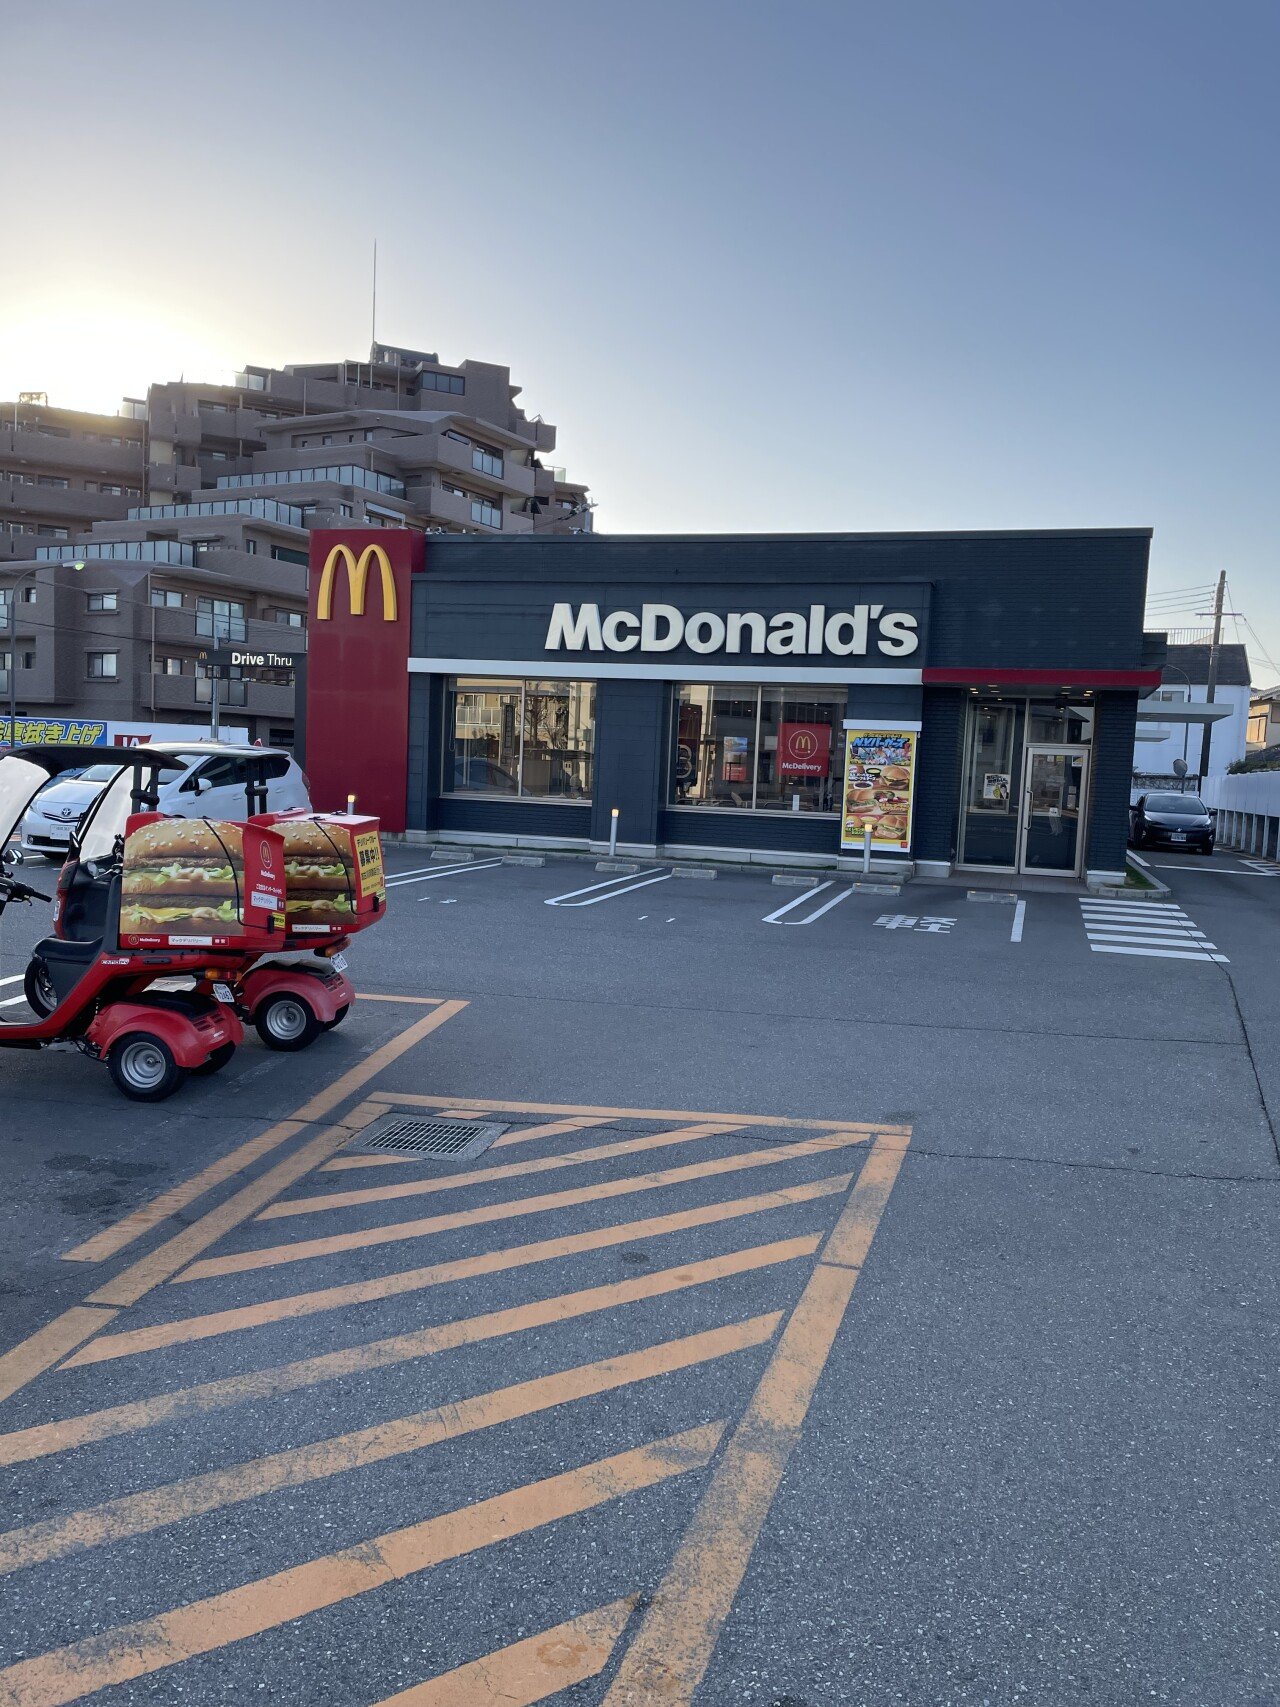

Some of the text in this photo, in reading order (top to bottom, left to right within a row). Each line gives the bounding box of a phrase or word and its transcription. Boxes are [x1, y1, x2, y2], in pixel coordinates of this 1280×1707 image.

[544, 603, 919, 657] McDonald's
[231, 652, 292, 666] Drive Thru
[782, 762, 821, 772] McDelivery
[872, 914, 957, 933] 軽
